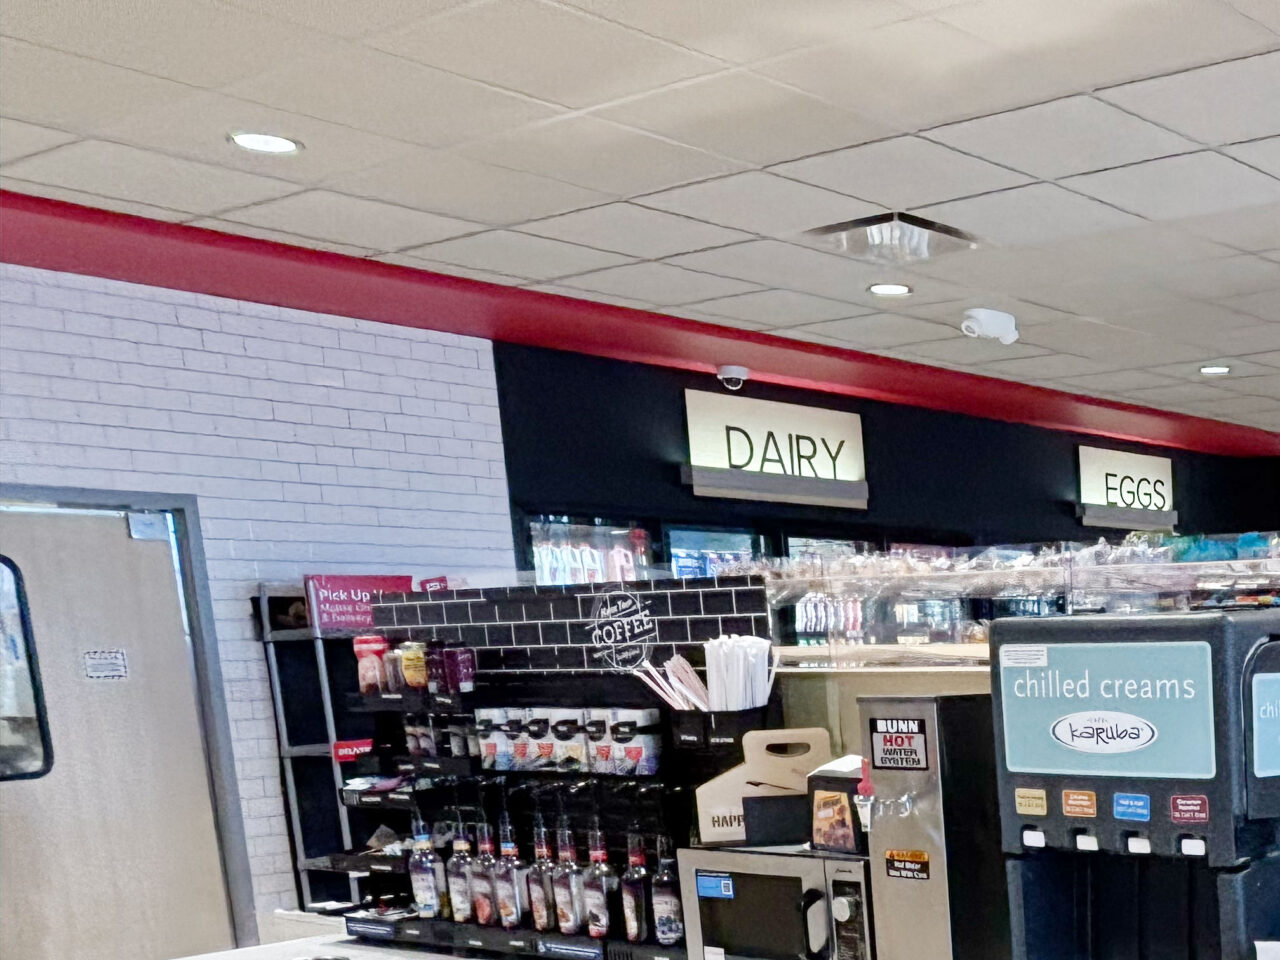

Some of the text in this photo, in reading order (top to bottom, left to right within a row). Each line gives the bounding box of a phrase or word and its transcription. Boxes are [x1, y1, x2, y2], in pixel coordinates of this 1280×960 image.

[725, 425, 846, 480] DAIRY
[1105, 472, 1166, 509] EGGS
[319, 589, 347, 601] Pick
[351, 589, 370, 602] Up
[592, 610, 653, 647] COFFEE
[1014, 669, 1196, 699] chilled creams
[876, 719, 919, 733] BUNN
[883, 734, 915, 747] HOT
[882, 747, 918, 757] WATER
